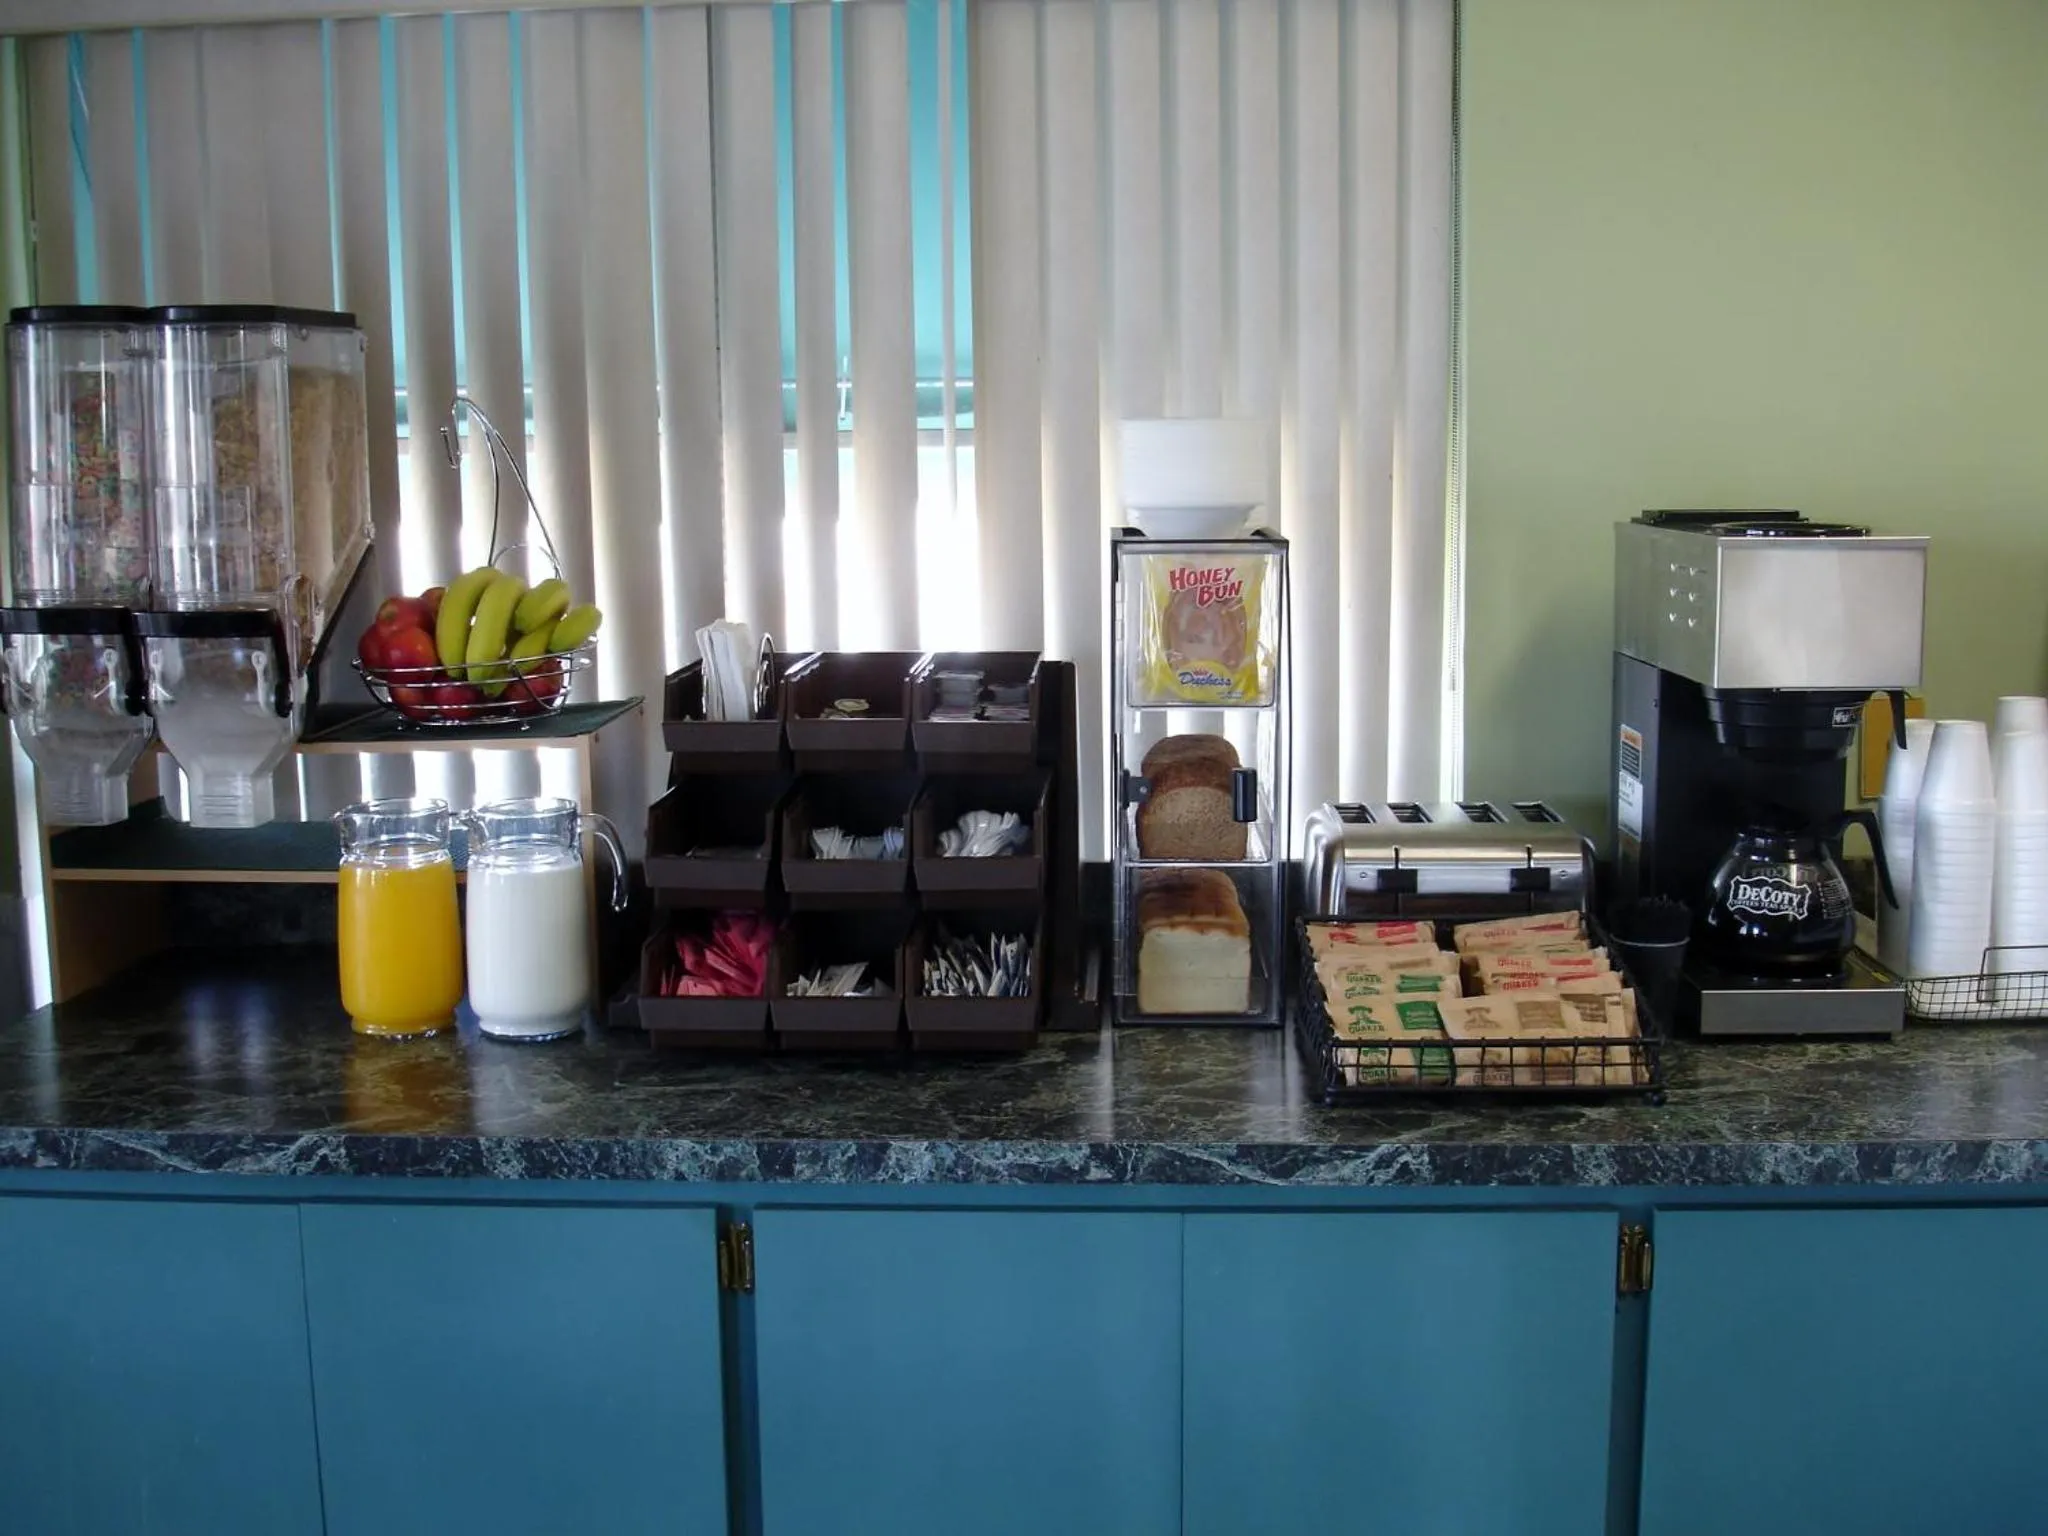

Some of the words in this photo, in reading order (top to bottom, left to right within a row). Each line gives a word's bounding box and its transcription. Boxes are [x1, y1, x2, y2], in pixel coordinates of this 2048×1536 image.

[1169, 567, 1235, 591] HONEY
[1199, 580, 1243, 607] BUN
[1361, 1068, 1398, 1080] QUAKR
